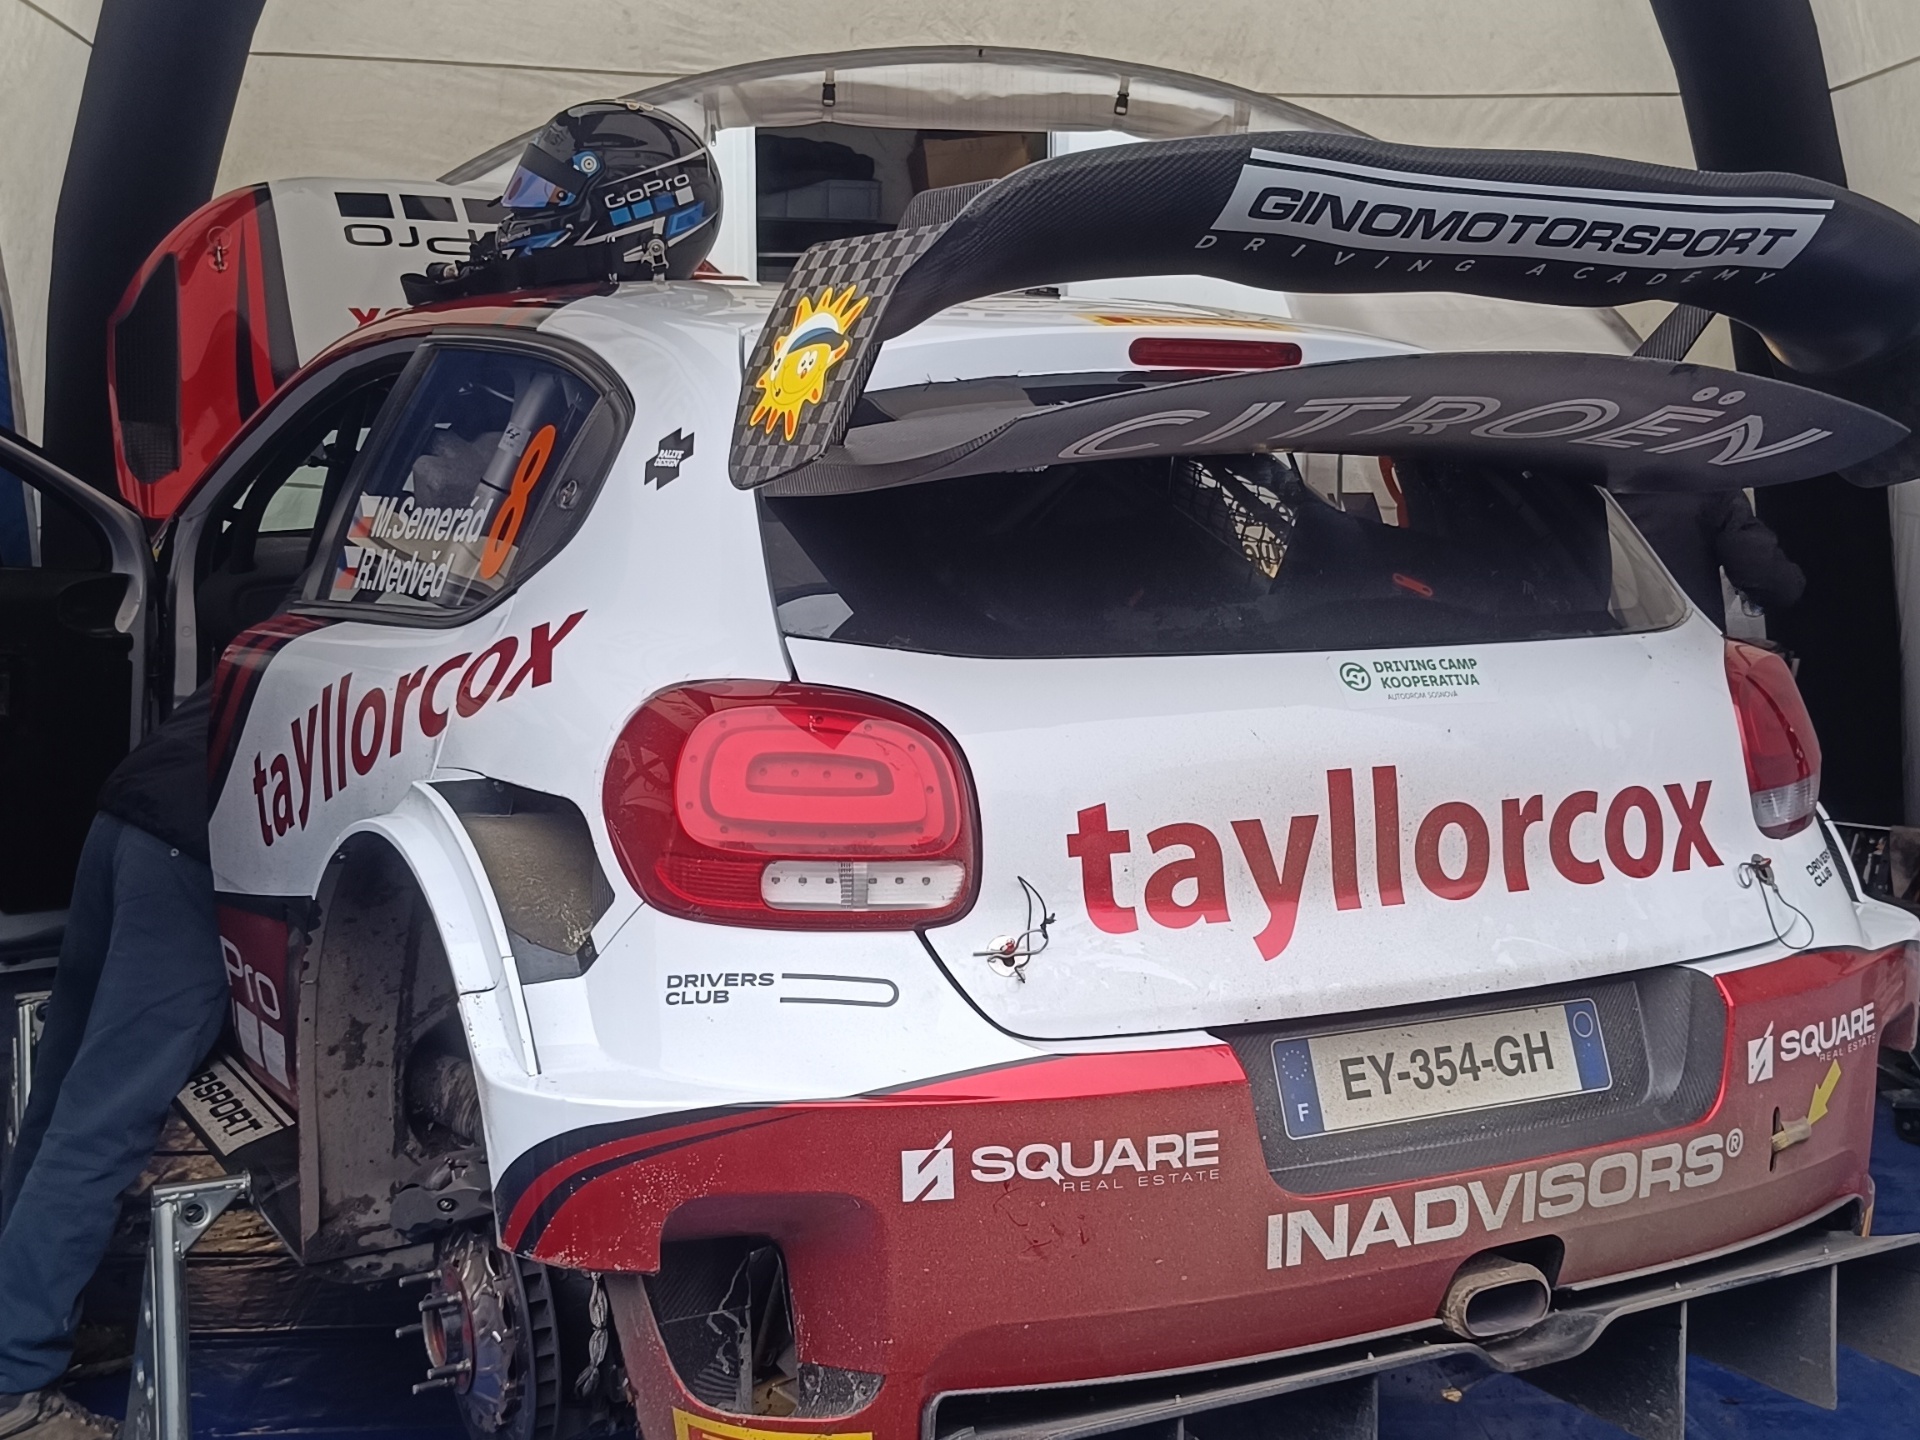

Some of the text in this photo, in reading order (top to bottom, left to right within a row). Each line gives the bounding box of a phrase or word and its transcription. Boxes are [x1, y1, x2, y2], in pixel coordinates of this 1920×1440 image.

[604, 173, 690, 209] GoPro
[1247, 186, 1798, 258] GINOMOTORSPORT
[1194, 235, 1776, 286] DRIVING ACADEMY
[1057, 386, 1833, 466] CITROËN
[479, 424, 556, 580] 8
[1372, 657, 1478, 673] DRIVING CAMP
[1380, 674, 1480, 689] KOOPERATIVA
[253, 609, 588, 847] tayllorcox
[1066, 764, 1724, 962] tayllorcox
[219, 935, 281, 1021] Pro
[665, 990, 730, 1006] CLUB
[666, 972, 775, 989] DRIVERS
[1780, 1001, 1876, 1062] SQUARE
[1819, 1050, 1844, 1063] REAL
[1297, 1030, 1555, 1122] F EY-354-GH
[969, 1129, 1219, 1186] SQUARE
[1062, 1168, 1220, 1193] REAL ESTATE
